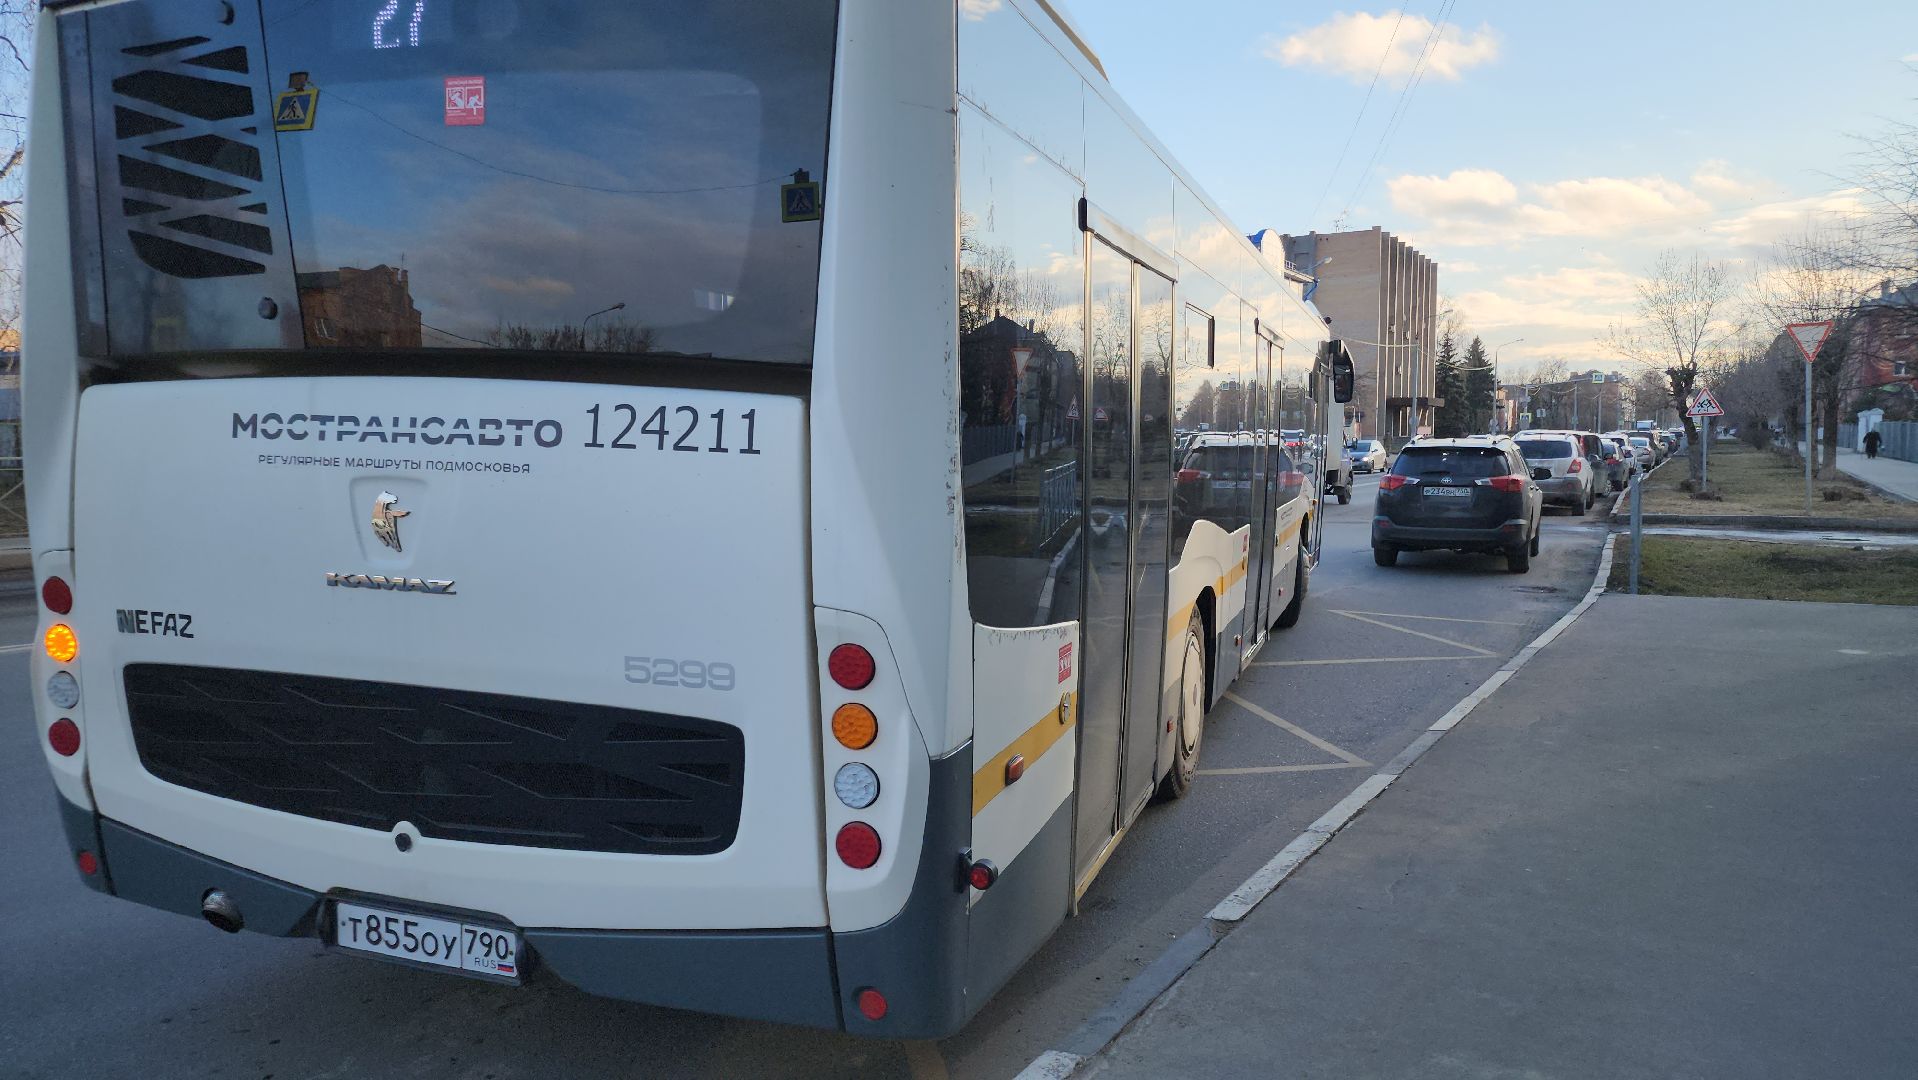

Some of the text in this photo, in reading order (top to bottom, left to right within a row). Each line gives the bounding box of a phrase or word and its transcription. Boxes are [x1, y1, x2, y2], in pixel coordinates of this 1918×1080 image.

[231, 412, 563, 448] МОСТРАНСАВТО
[584, 403, 761, 455] 124211
[258, 454, 531, 474] РЕГУЛЯРНЫЕ МАРШРУТЫ ПОДМОСКОВЬЯ
[325, 572, 457, 595] KAMAZ
[116, 608, 194, 639] NEFAZ
[624, 655, 736, 692] 5299
[348, 914, 509, 961] Т855ОУ 790
[474, 957, 497, 969] RUS
